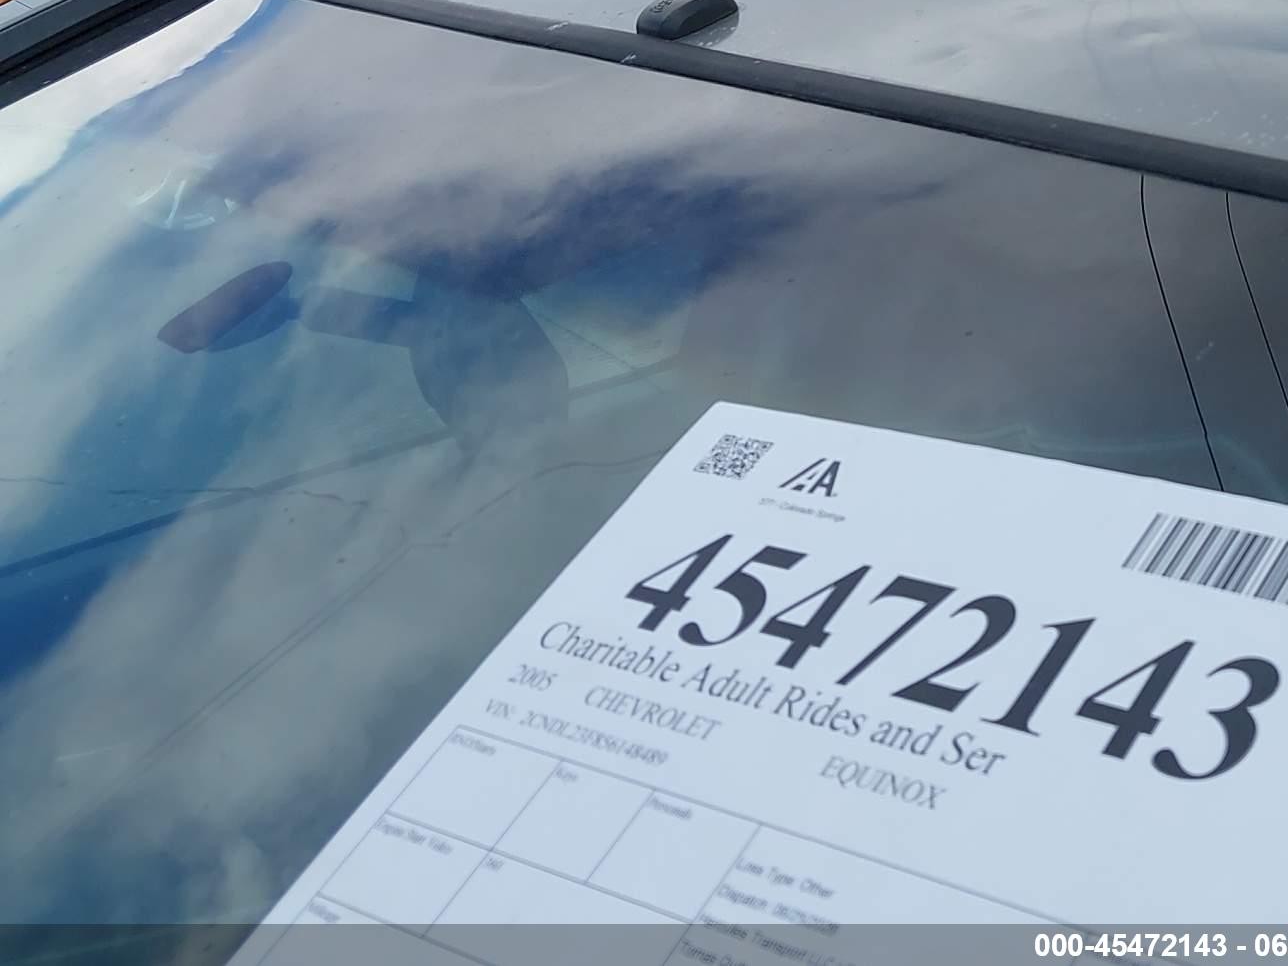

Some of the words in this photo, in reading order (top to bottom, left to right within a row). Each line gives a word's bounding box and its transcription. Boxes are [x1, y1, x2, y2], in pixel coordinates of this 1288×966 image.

[508, 663, 558, 692] 2005
[625, 533, 1282, 782] 45472143
[539, 620, 680, 684] Charitable
[680, 663, 773, 709] Adult
[773, 684, 863, 736] Rides
[869, 716, 939, 757] and
[940, 731, 1007, 777] Ser
[584, 684, 722, 741] CHEVROLET
[819, 754, 948, 810] EQUINOX
